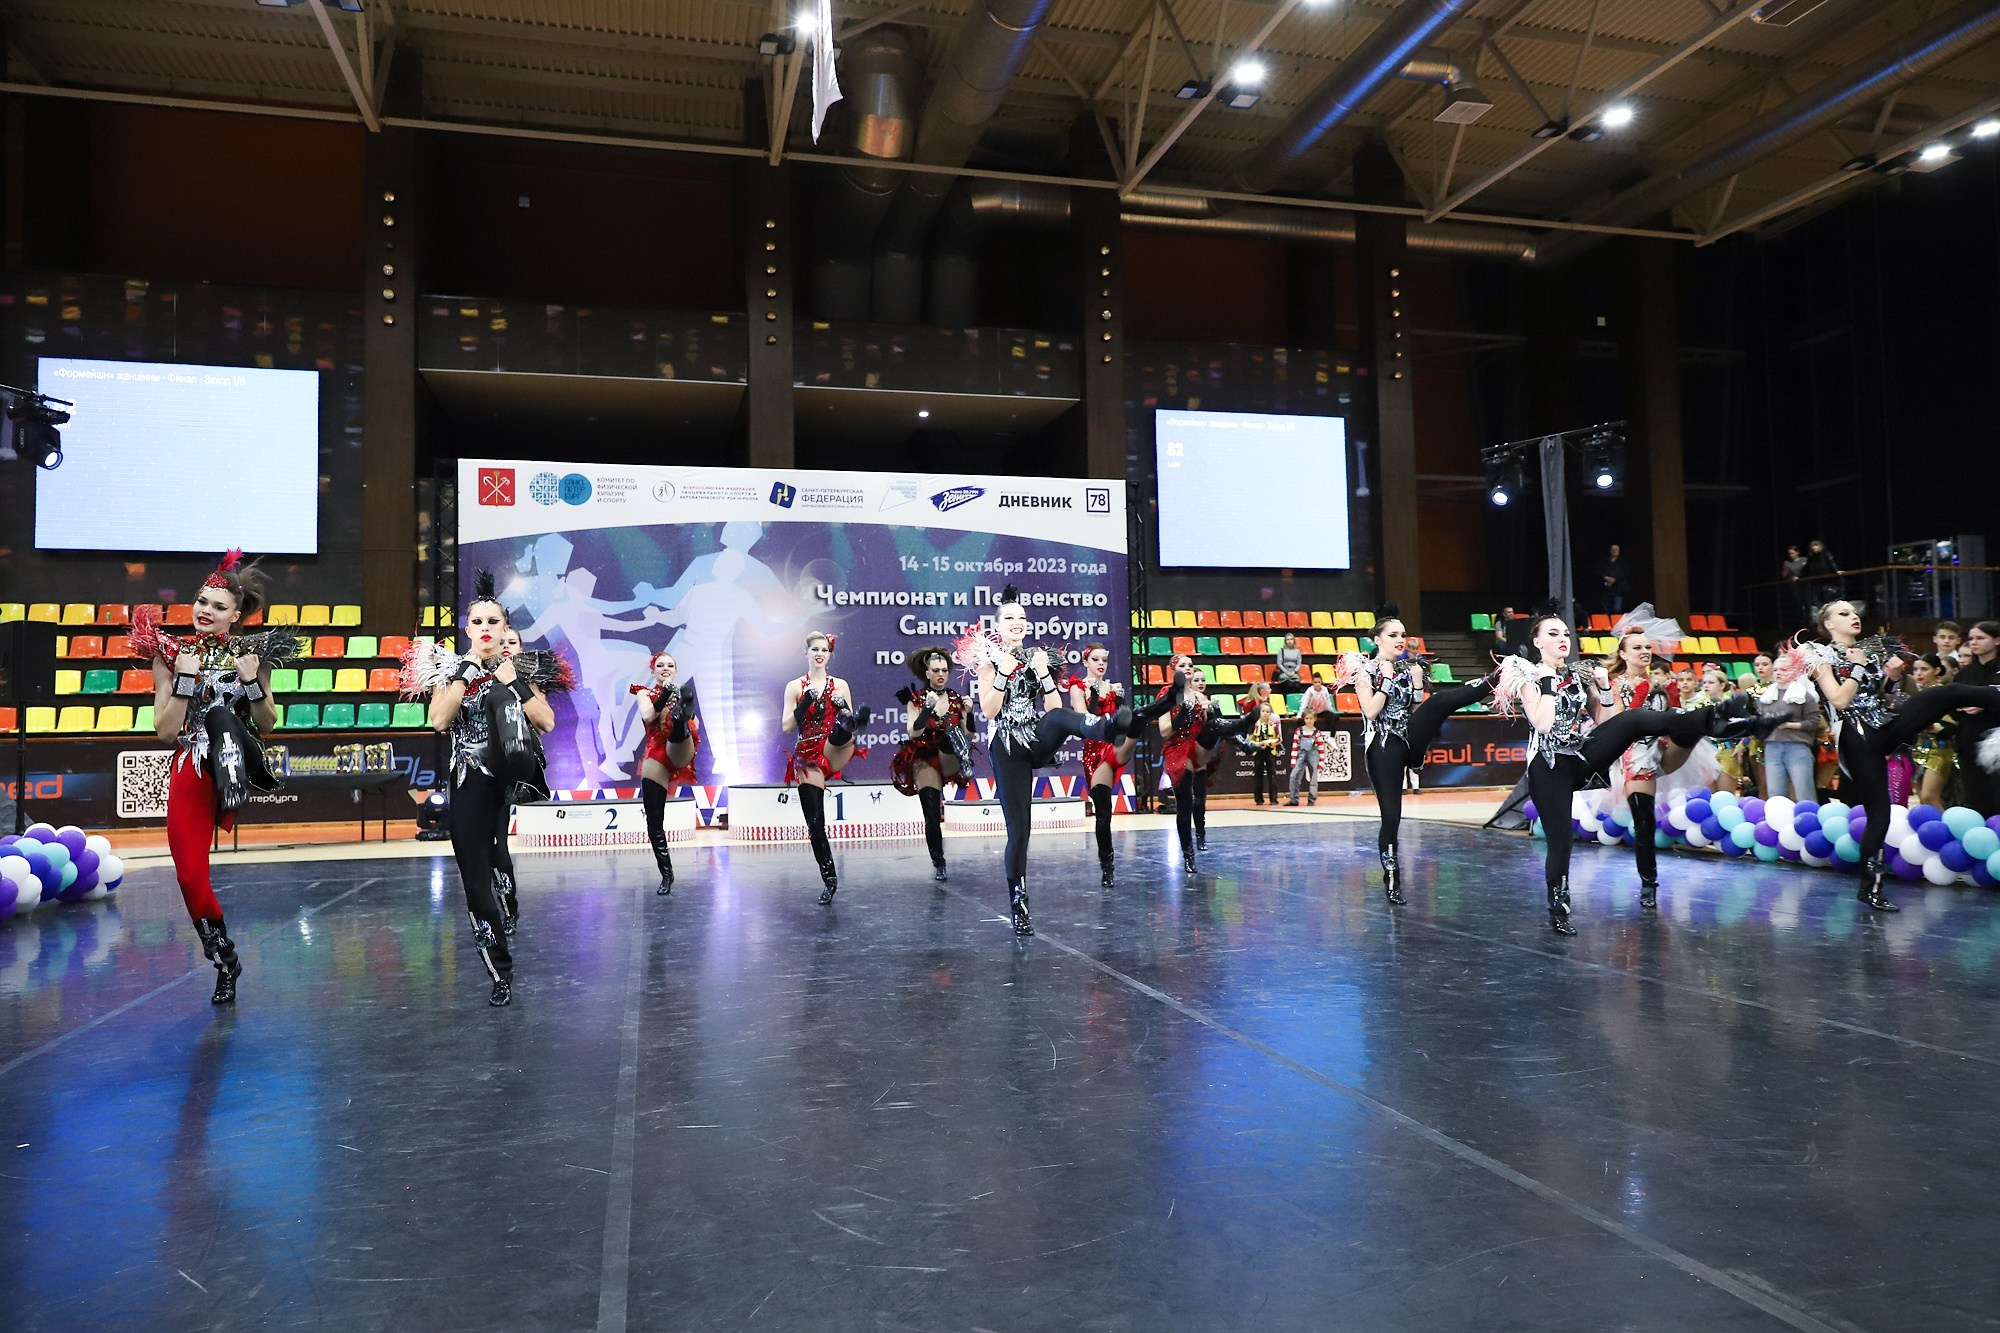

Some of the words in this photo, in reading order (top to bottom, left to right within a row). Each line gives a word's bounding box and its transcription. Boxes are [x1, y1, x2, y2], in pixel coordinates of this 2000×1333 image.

[801, 494, 864, 504] ФЕДЕРАЦИЯ
[998, 495, 1073, 509] ДНЕВНИК
[1090, 494, 1106, 508] 78
[899, 556, 920, 571] 14
[932, 557, 950, 571] 15
[954, 557, 1023, 576] октября
[1027, 557, 1067, 573] 2023
[1071, 562, 1107, 575] года
[816, 584, 949, 606] Чемпионат
[954, 591, 968, 605] и
[974, 585, 1108, 606] Певенство
[899, 614, 1108, 640] Санкт-Пербурга
[877, 650, 905, 665] по
[832, 792, 847, 821] 1
[605, 808, 618, 830] 2
